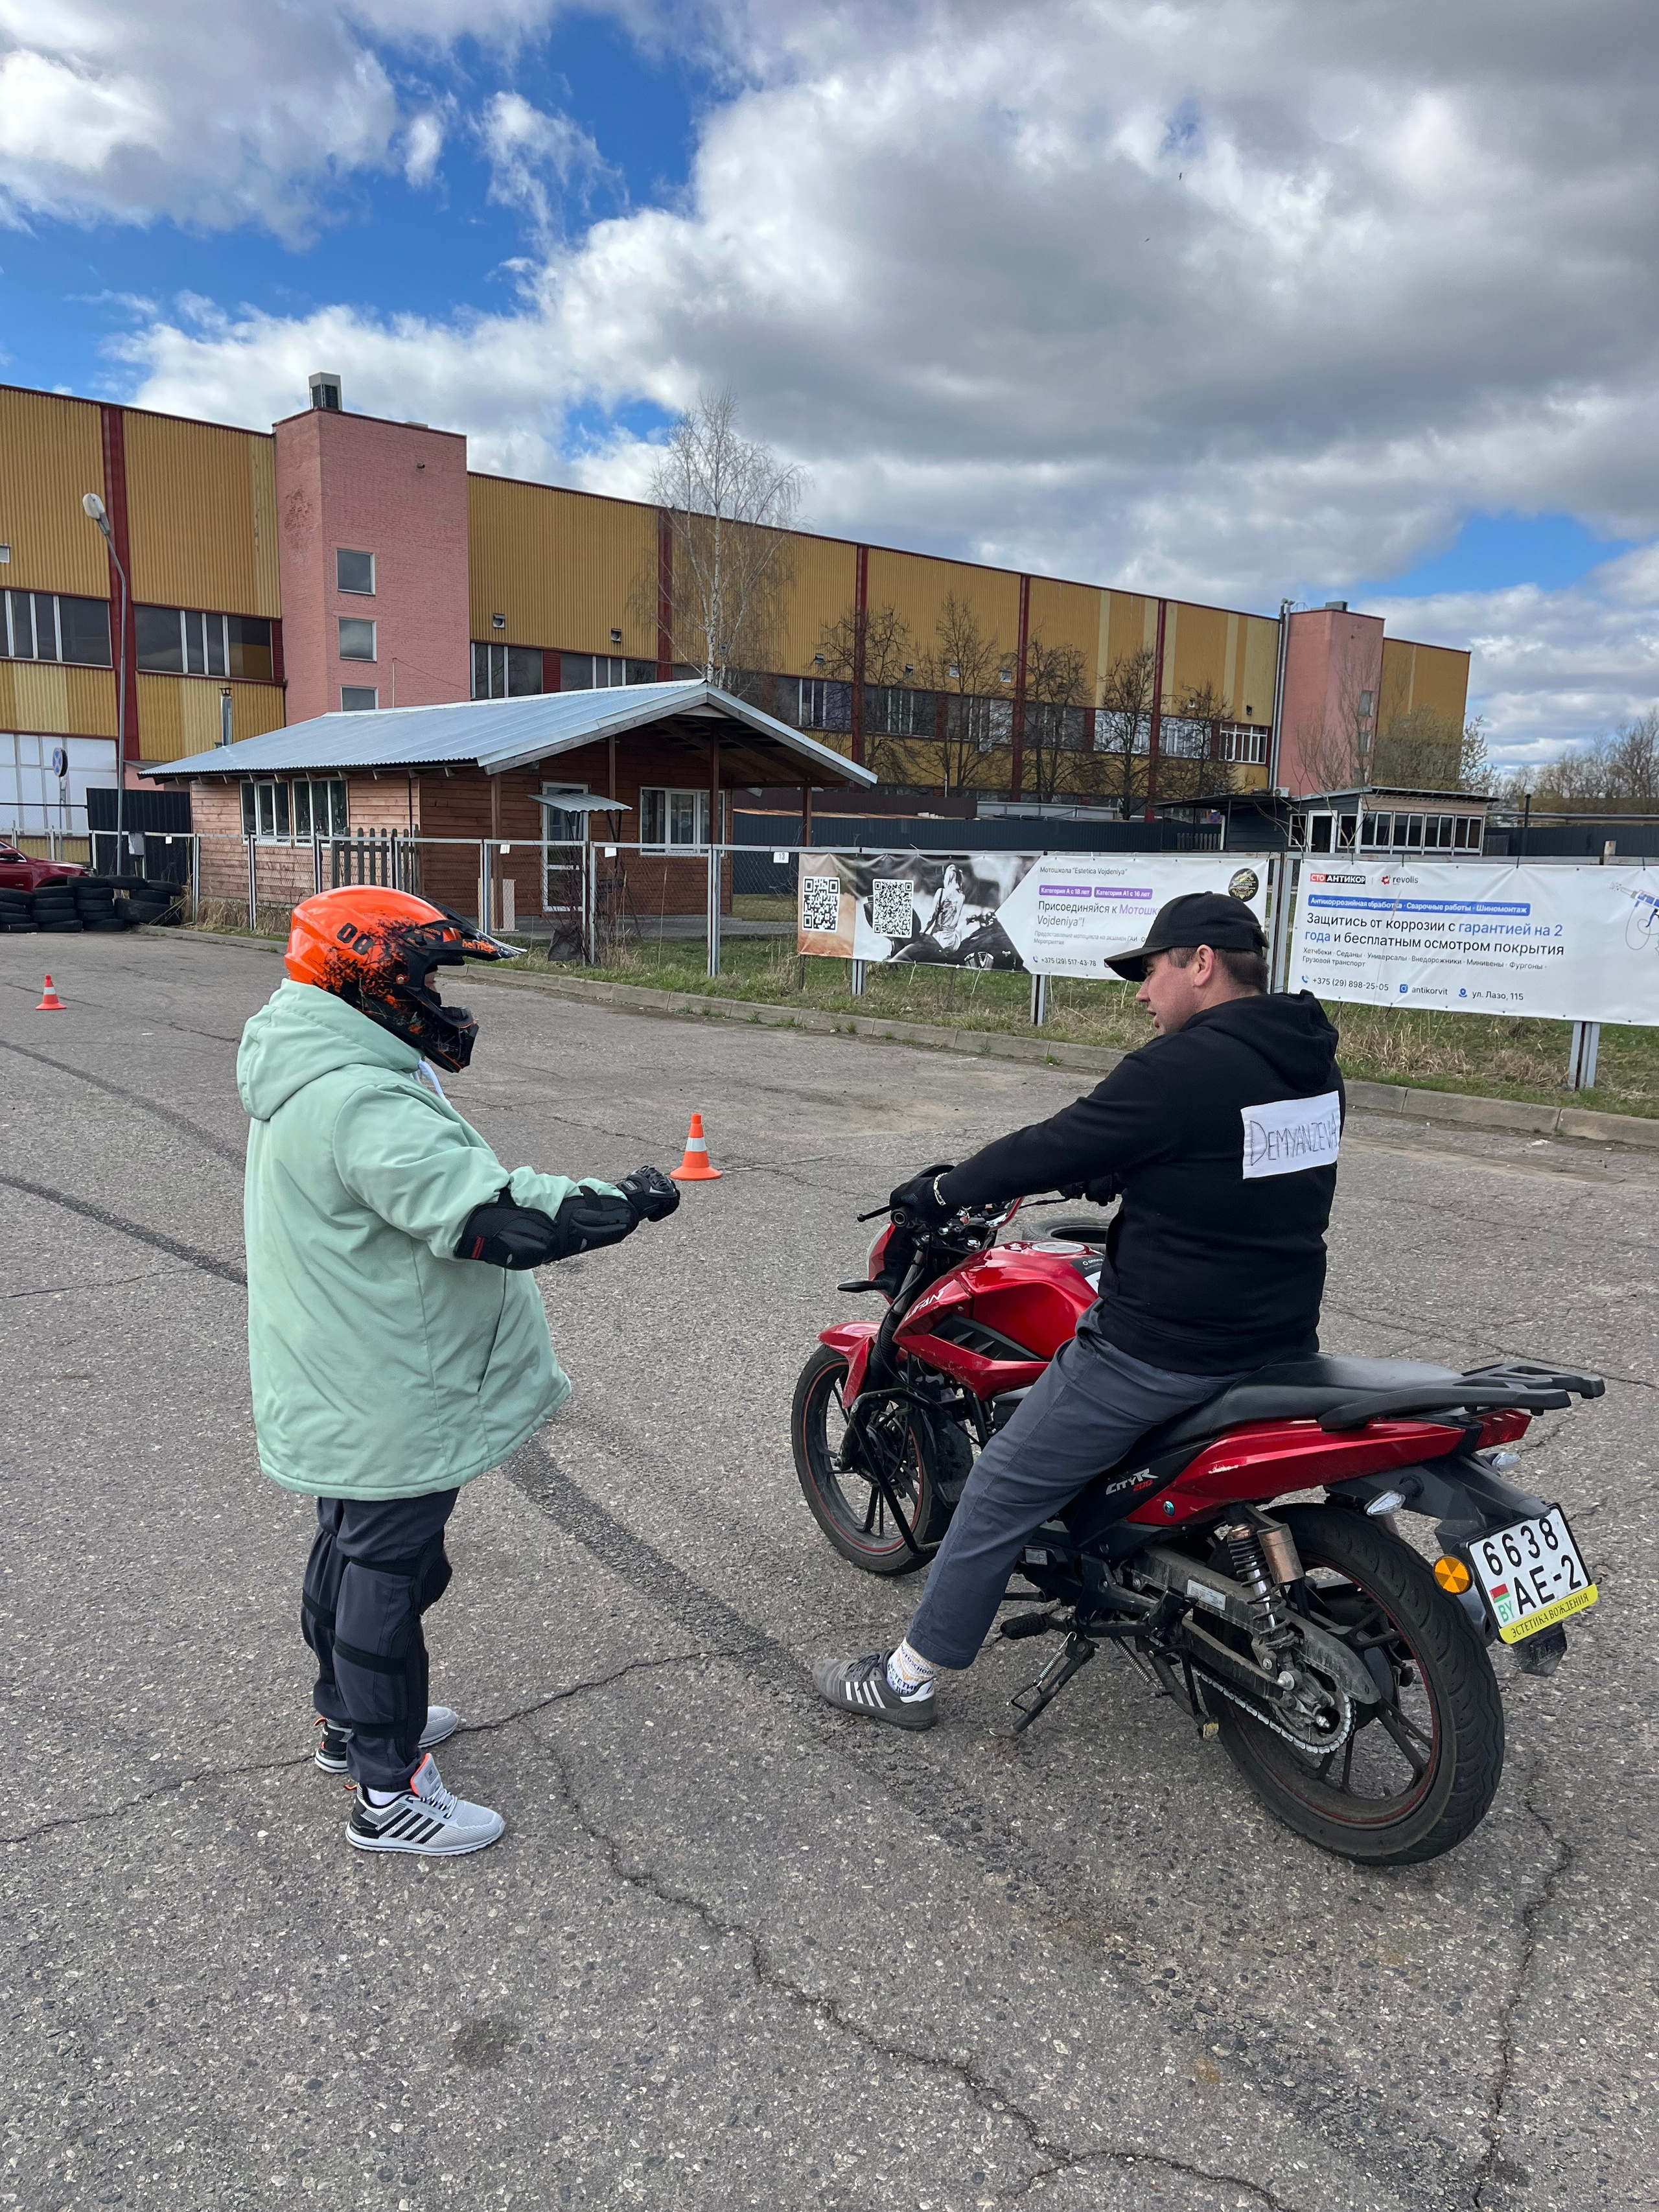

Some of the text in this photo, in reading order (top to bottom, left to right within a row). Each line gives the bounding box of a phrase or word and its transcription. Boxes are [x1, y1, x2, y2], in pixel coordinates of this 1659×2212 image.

[1327, 875, 1365, 883] АНТИКОР
[1039, 900, 1109, 914] Присоединяйся
[1112, 905, 1117, 914] к
[1311, 897, 1367, 907] Антикоррозийная
[1406, 902, 1443, 911] Сварочные
[1476, 904, 1527, 913] Шиномонтаж
[1307, 913, 1562, 937] Защитись от коррозии с гарантией на 2
[1305, 931, 1564, 956] года и бесплатным осмотром покрытия
[1056, 957, 1067, 965] (29)
[1303, 956, 1330, 964] Грузовой
[1367, 953, 1407, 961] Универсалы
[1411, 955, 1461, 964] Внедорожники
[1467, 959, 1503, 968] Минивены
[1332, 979, 1347, 987] (29)
[1349, 980, 1389, 991] 898-25-05
[1411, 986, 1448, 995] antikorvit
[1485, 991, 1508, 1001] Лазо,
[904, 1290, 944, 1322] LIFAN
[1483, 1518, 1559, 1576] 6638
[1514, 1555, 1582, 1614] AE-2
[1498, 1600, 1515, 1622] BY
[1511, 1593, 1589, 1638] ЭСТЕТИКА ВОЖДЕНИЯ
